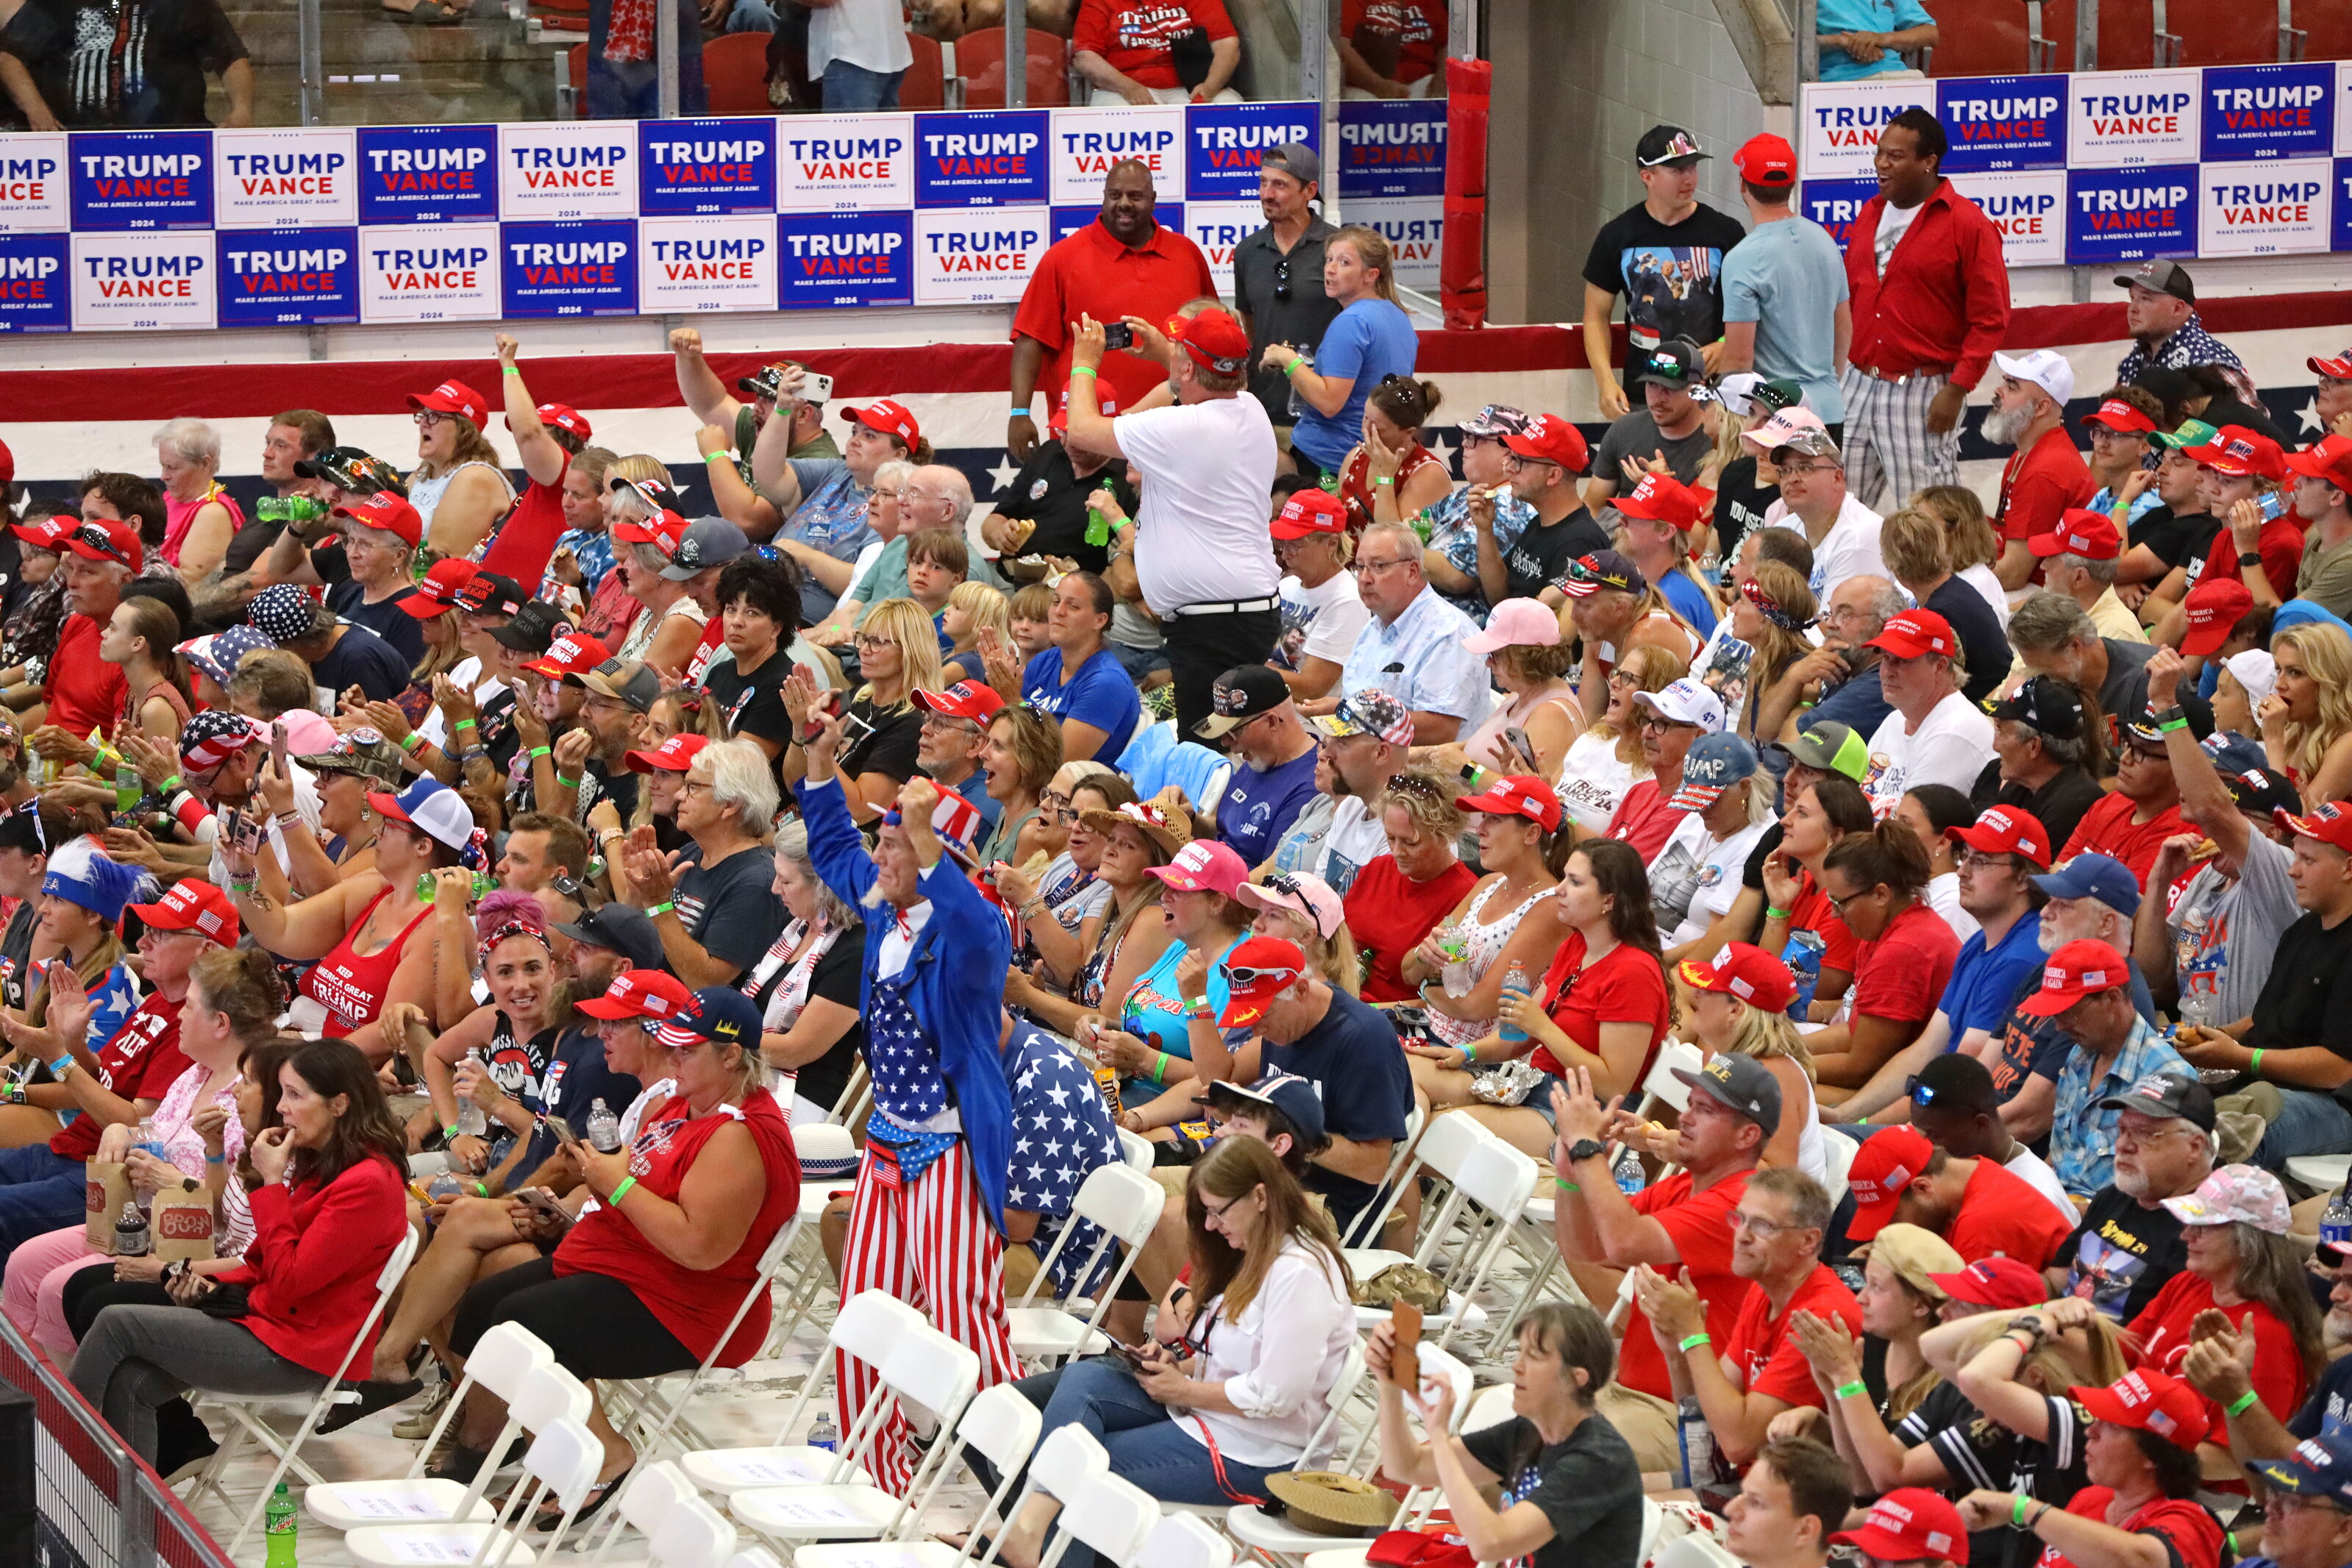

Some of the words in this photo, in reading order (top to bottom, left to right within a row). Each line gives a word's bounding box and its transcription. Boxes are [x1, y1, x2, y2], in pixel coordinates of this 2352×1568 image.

[2081, 93, 2189, 117] TRUMP
[2212, 85, 2323, 110] TRUMP
[1947, 96, 2058, 121] TRUMP
[2093, 116, 2177, 136] VANCE
[2225, 108, 2310, 129] VANCE
[1196, 125, 1308, 149] TRUMP
[1828, 129, 1878, 147] VAN
[1961, 120, 2045, 140] VANCE
[790, 138, 902, 160] TRUMP
[924, 132, 1038, 157] TRUMP
[1063, 131, 1173, 153] TRUMP
[368, 148, 485, 171] TRUMP
[512, 146, 626, 168] TRUMP
[649, 140, 764, 164] TRUMP
[1209, 149, 1263, 168] VAN
[2123, 156, 2145, 164] 2024
[2254, 148, 2278, 157] 2024
[80, 154, 201, 178] TRUMP
[227, 154, 344, 176] TRUMP
[663, 163, 752, 183] VANCE
[802, 162, 889, 179] VANCE
[938, 156, 1026, 176] VANCE
[1766, 160, 1789, 168] TRUMP
[1989, 160, 2013, 168] 2024
[95, 178, 188, 198] VANCE
[241, 177, 332, 195] VANCE
[382, 171, 474, 191] VANCE
[525, 169, 613, 188] VANCE
[676, 185, 709, 193] AMERICA
[2212, 182, 2320, 206] TRUMP
[109, 200, 143, 208] AMERICA
[144, 199, 169, 207] GREAT
[169, 199, 196, 207] AGAIN!
[695, 204, 720, 212] 2024
[969, 196, 994, 204] 2024
[2078, 186, 2187, 212] TRUMP
[129, 219, 155, 227] 2024
[416, 212, 441, 220] 2024
[2090, 209, 2175, 230] VANCE
[2223, 205, 2307, 224] VANCE
[788, 232, 902, 256] TRUMP
[927, 229, 1038, 253] TRUMP
[2102, 232, 2134, 240] AMERICA
[2157, 229, 2182, 238] AGAIN!
[372, 247, 487, 271] TRUMP
[510, 242, 627, 265] TRUMP
[652, 238, 764, 261] TRUMP
[2120, 249, 2143, 258] 2024
[85, 255, 203, 277] TRUMP
[227, 249, 346, 273] TRUMP
[801, 256, 889, 275] VANCE
[940, 253, 1025, 273] VANCE
[386, 271, 475, 290] VANCE
[524, 266, 614, 285] VANCE
[665, 262, 752, 280] VANCE
[99, 279, 190, 298] VANCE
[243, 273, 335, 293] VANCE
[557, 305, 582, 314] 2024
[833, 296, 858, 304] 2024
[277, 313, 302, 322] 2024
[420, 311, 443, 319] 2024
[2189, 607, 2214, 616] AMERICA
[2193, 615, 2213, 624] AGAIN
[1897, 619, 1921, 631] AMERICA
[1897, 626, 1917, 635] AGAIN
[1703, 712, 1717, 724] 47
[1683, 754, 1725, 780] UMP
[1558, 782, 1592, 803] VANCE
[1573, 779, 1611, 797] TRUMP
[336, 965, 354, 979] KEEP
[313, 978, 368, 1022] TRUMP
[343, 983, 374, 1002] GREAT
